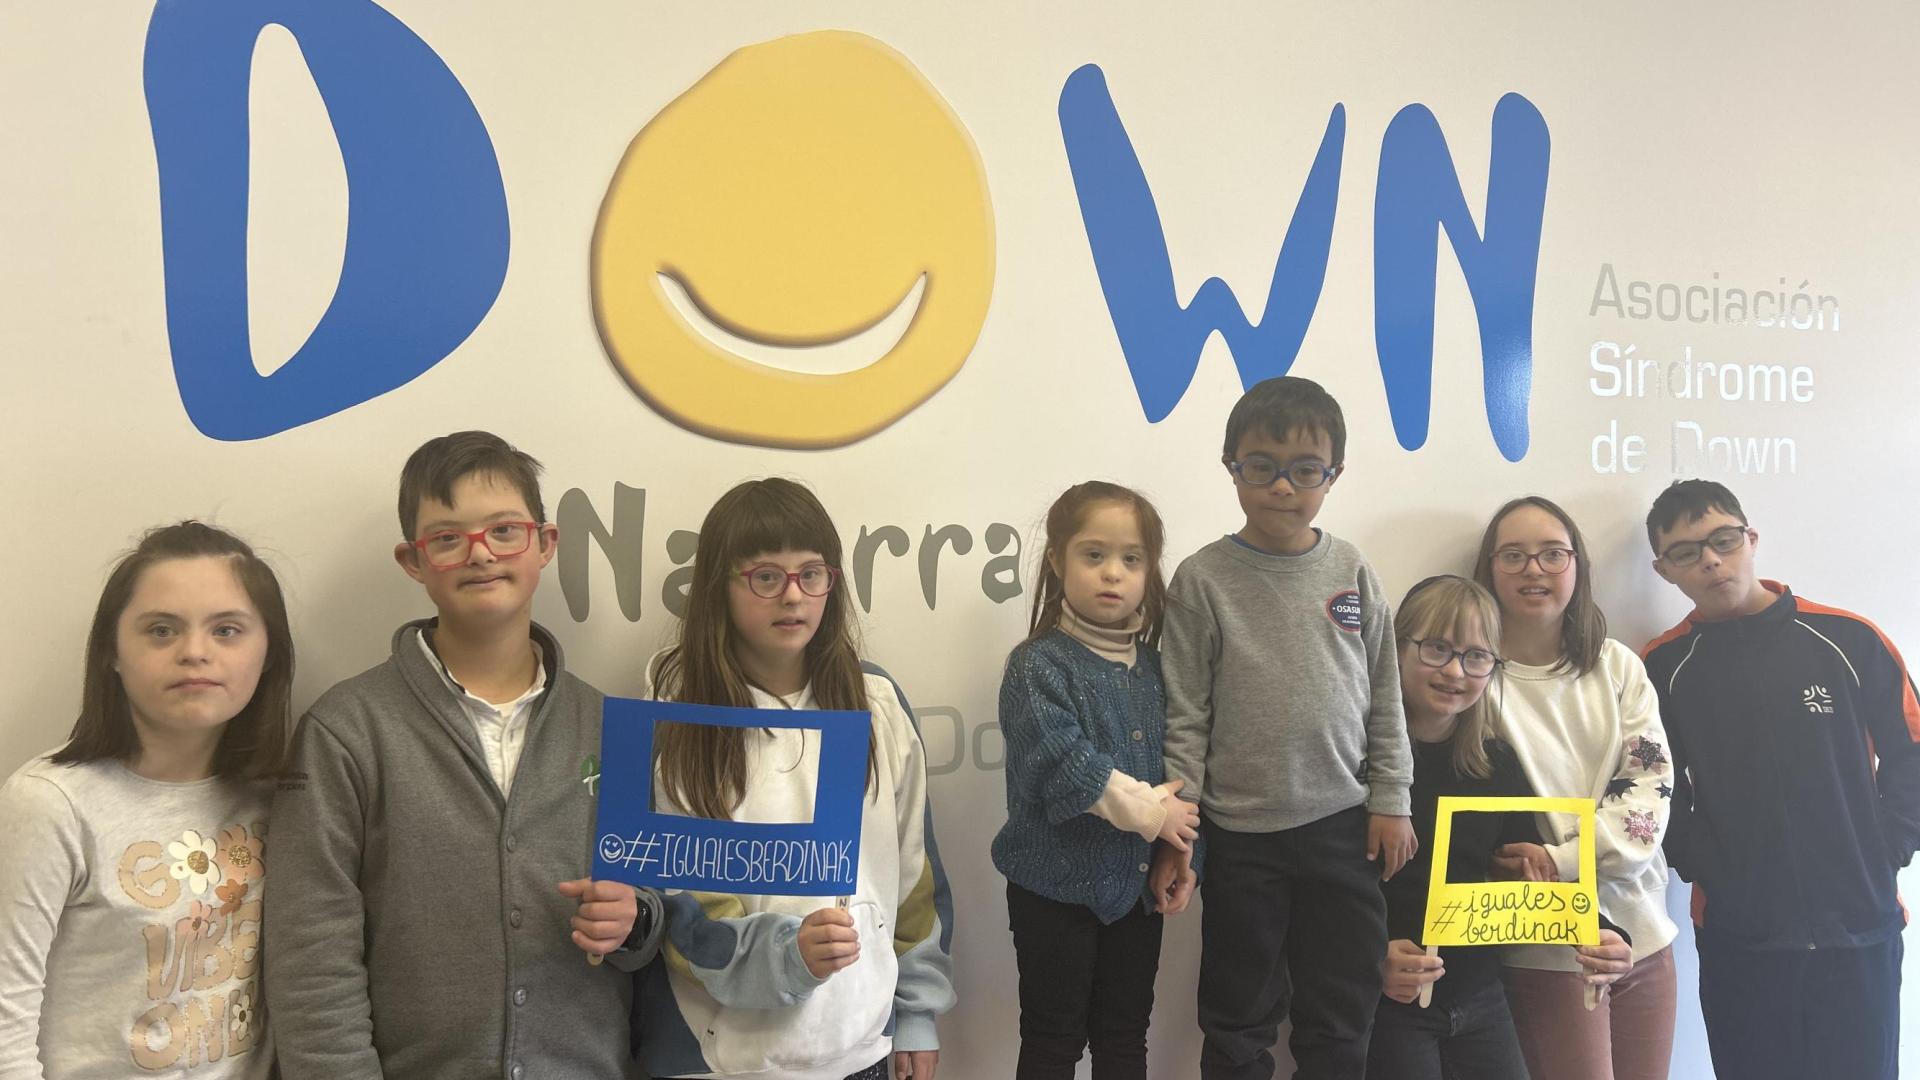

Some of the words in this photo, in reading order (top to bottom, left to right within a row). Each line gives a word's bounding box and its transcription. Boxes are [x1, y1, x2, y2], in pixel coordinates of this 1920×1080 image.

[1589, 263, 1840, 331] Asociación
[1589, 340, 1815, 403] Síndrome
[1591, 419, 1646, 474] de
[1671, 420, 1796, 474] Down
[557, 481, 1023, 623] Narra
[1336, 605, 1360, 614] OSASU
[622, 831, 853, 884] #IGUALESBERDINAK
[142, 900, 262, 1000] VIBE
[1460, 913, 1580, 944] berdinak
